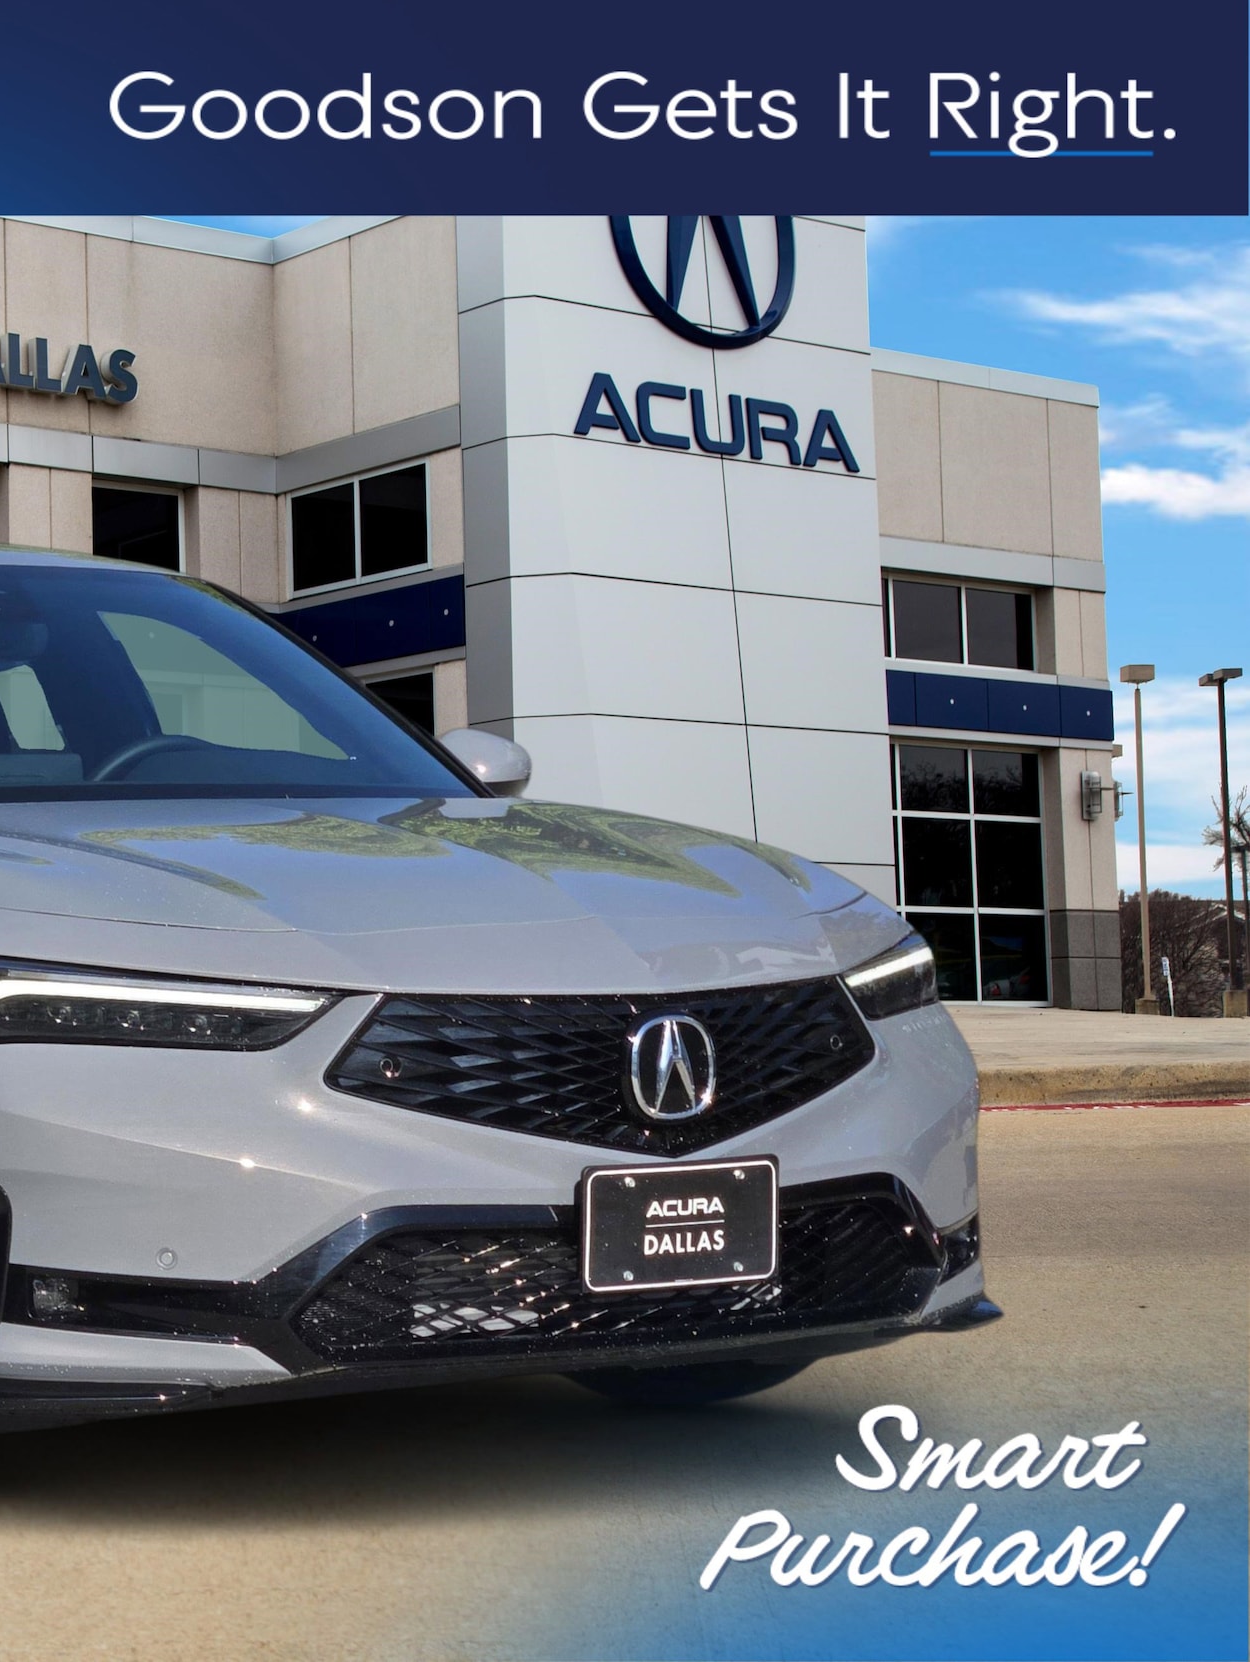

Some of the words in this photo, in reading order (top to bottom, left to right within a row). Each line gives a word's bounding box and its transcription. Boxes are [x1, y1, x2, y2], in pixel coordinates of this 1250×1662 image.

[574, 372, 860, 472] ACURA
[645, 1196, 725, 1218] ACURA
[643, 1229, 725, 1256] DALLAS
